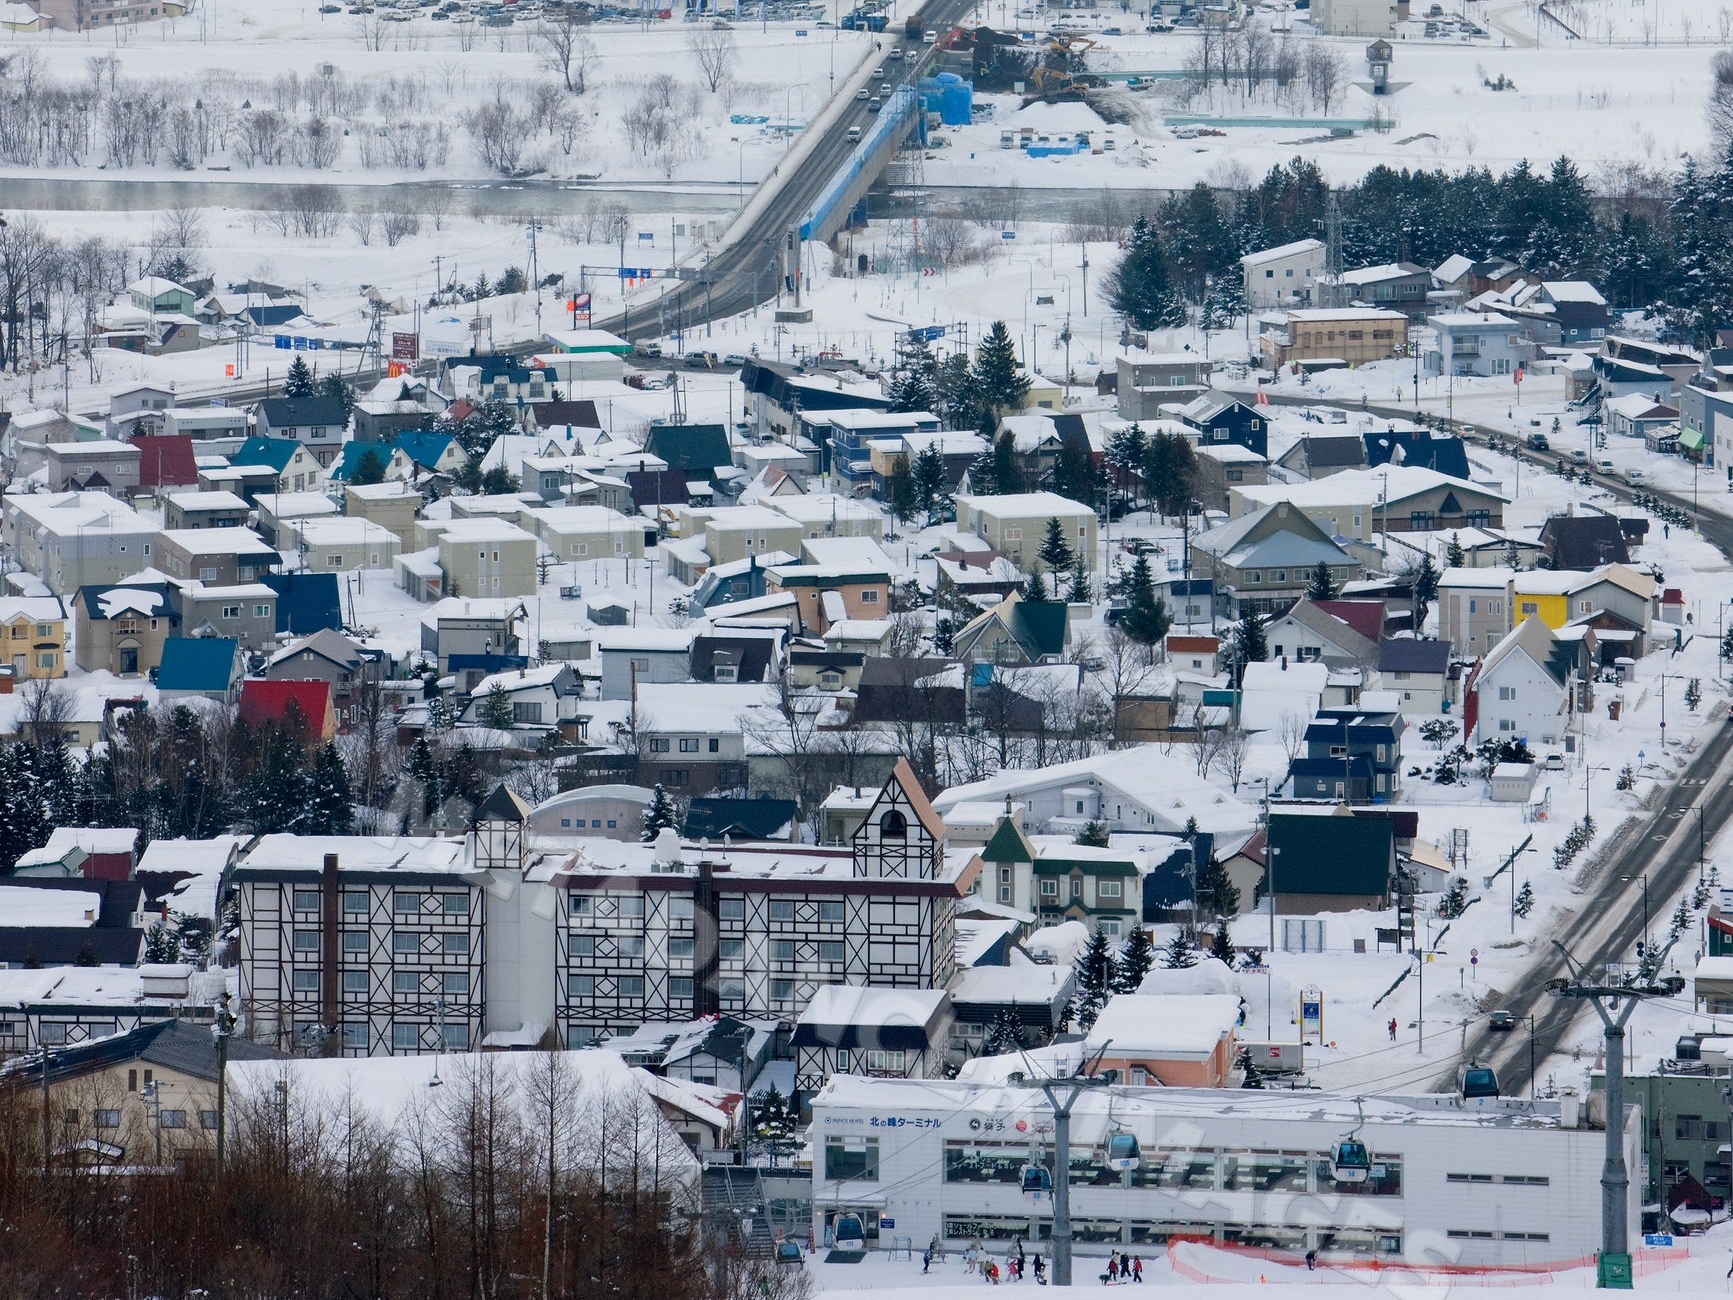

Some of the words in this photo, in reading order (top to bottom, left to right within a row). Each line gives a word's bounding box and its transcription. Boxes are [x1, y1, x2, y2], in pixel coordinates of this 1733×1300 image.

[1478, 1098, 1484, 1106] 2
[870, 1116, 942, 1128] 北の峰ターミナル
[1347, 1170, 1356, 1178] 14
